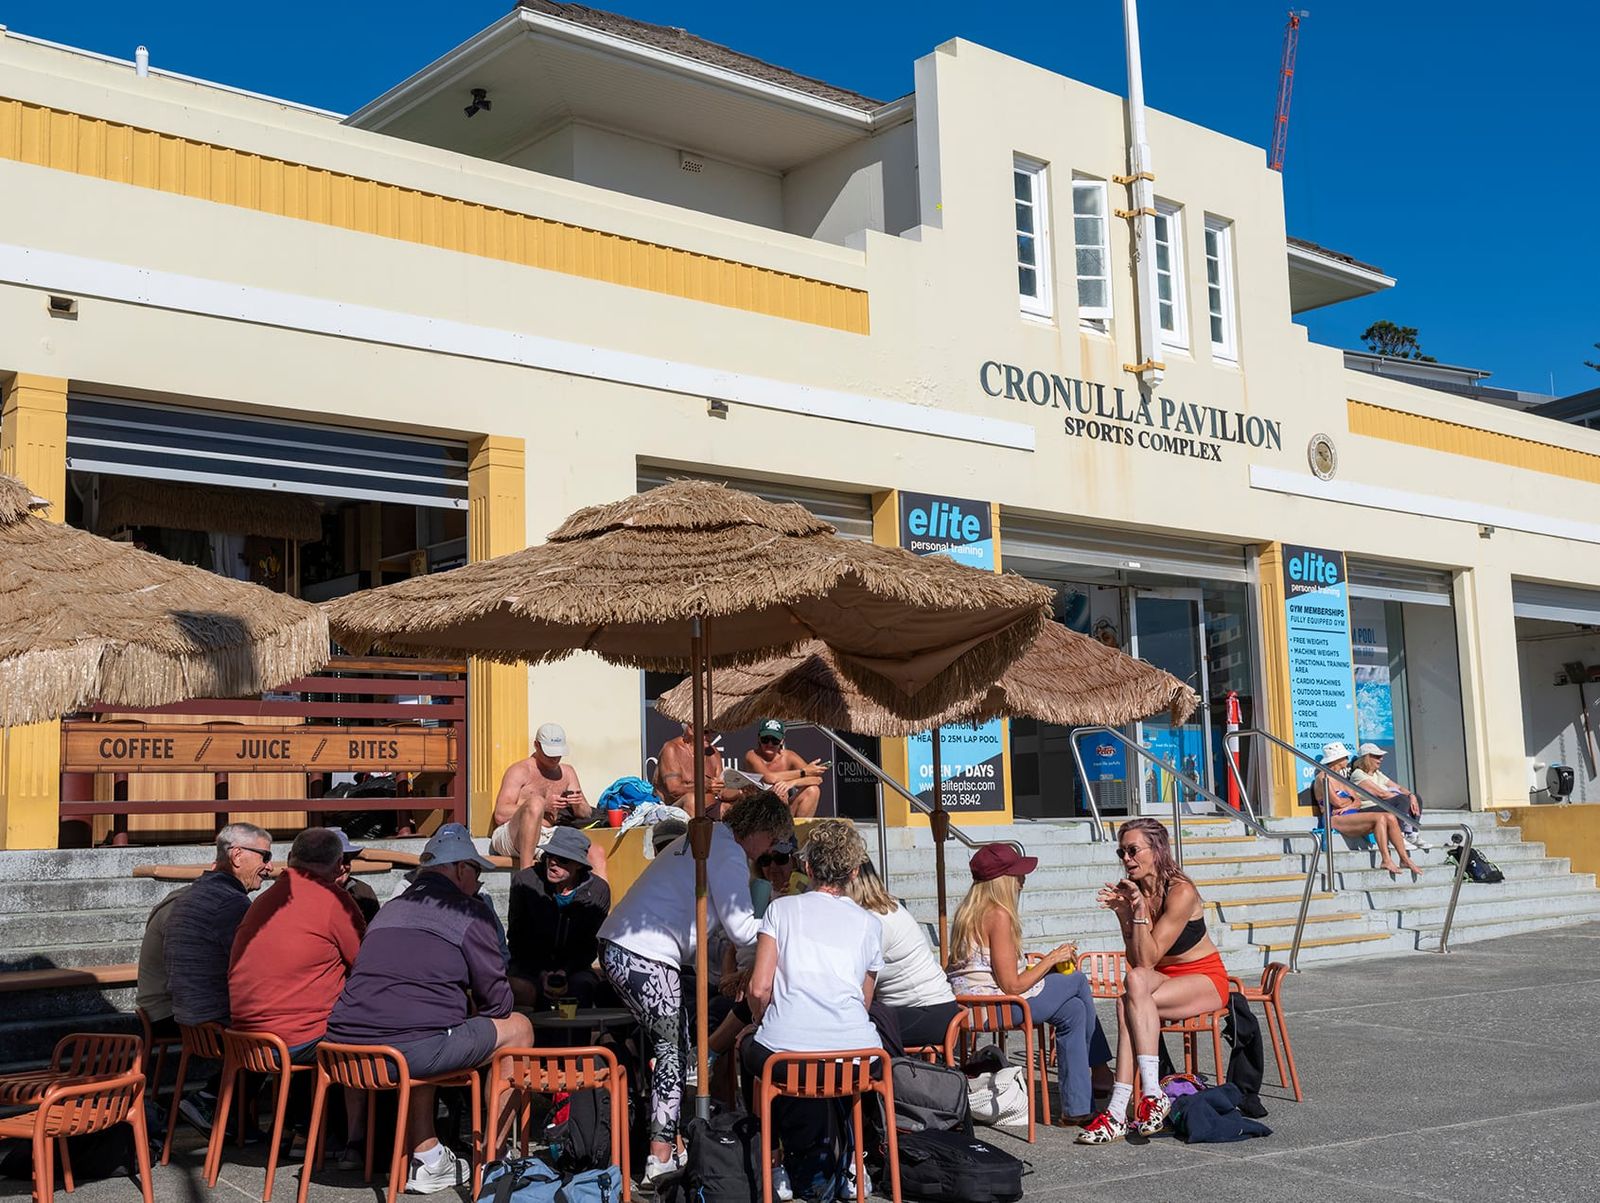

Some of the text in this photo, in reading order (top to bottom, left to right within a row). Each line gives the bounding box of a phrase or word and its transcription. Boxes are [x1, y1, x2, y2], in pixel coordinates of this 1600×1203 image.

[980, 360, 1282, 451] CRONULLA PAVILION
[1064, 416, 1222, 462] SPORTS COMPLEX
[908, 502, 980, 541] elite
[911, 541, 983, 558] personal training
[1289, 552, 1338, 584] elite
[1291, 584, 1317, 592] personal
[1290, 605, 1345, 617] GYM MEMBERSHIPS
[1307, 617, 1333, 626] EQUIPPED
[1358, 627, 1377, 644] POOL
[1306, 638, 1329, 646] WEIGHTS
[1317, 649, 1340, 657] WEIGHTS
[1295, 659, 1350, 669] FUNCTIONAL TRAINING
[1296, 677, 1315, 685] CARDIO
[1296, 688, 1321, 696] OUTDOOR
[917, 734, 946, 743] HEAD
[947, 735, 962, 743] 25M
[963, 735, 977, 743] LAP
[99, 738, 174, 759] COFFEE
[236, 739, 291, 759] JUICE
[349, 740, 399, 759] BITES
[920, 764, 994, 777] OPN 7 DAYS
[959, 793, 981, 805] 5842
